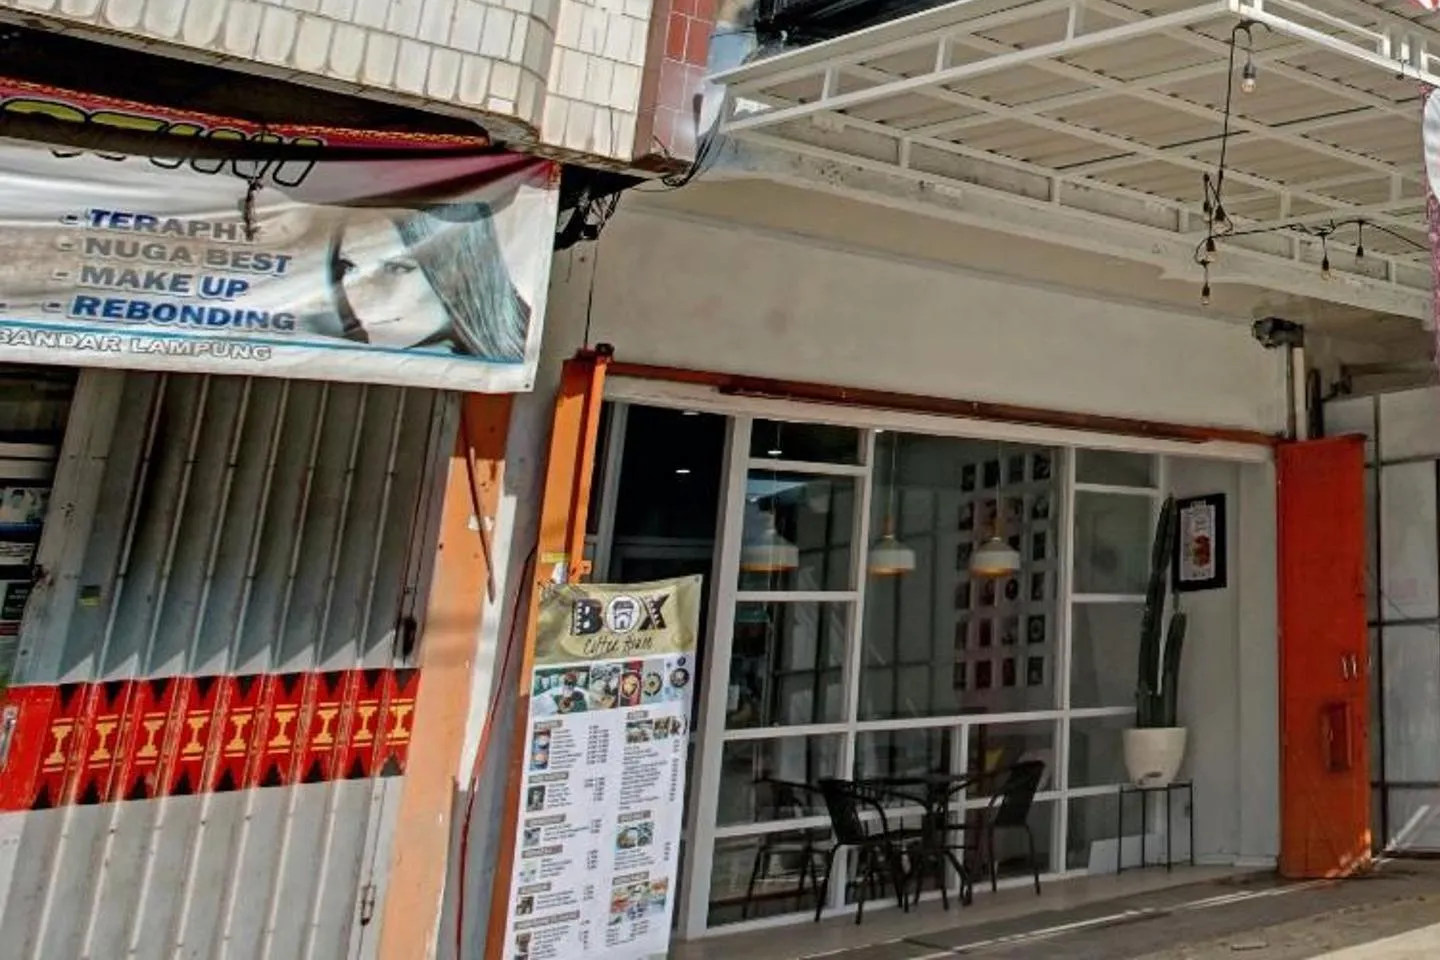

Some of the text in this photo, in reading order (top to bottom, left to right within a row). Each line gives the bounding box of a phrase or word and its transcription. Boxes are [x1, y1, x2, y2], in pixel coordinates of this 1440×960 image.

[89, 208, 262, 242] TERAPHY
[85, 237, 293, 274] NUGA BEST
[80, 265, 250, 299] MAKE UP
[71, 295, 296, 331] REBONDING
[131, 337, 272, 360] LAMPUNG
[570, 593, 670, 637] BOX
